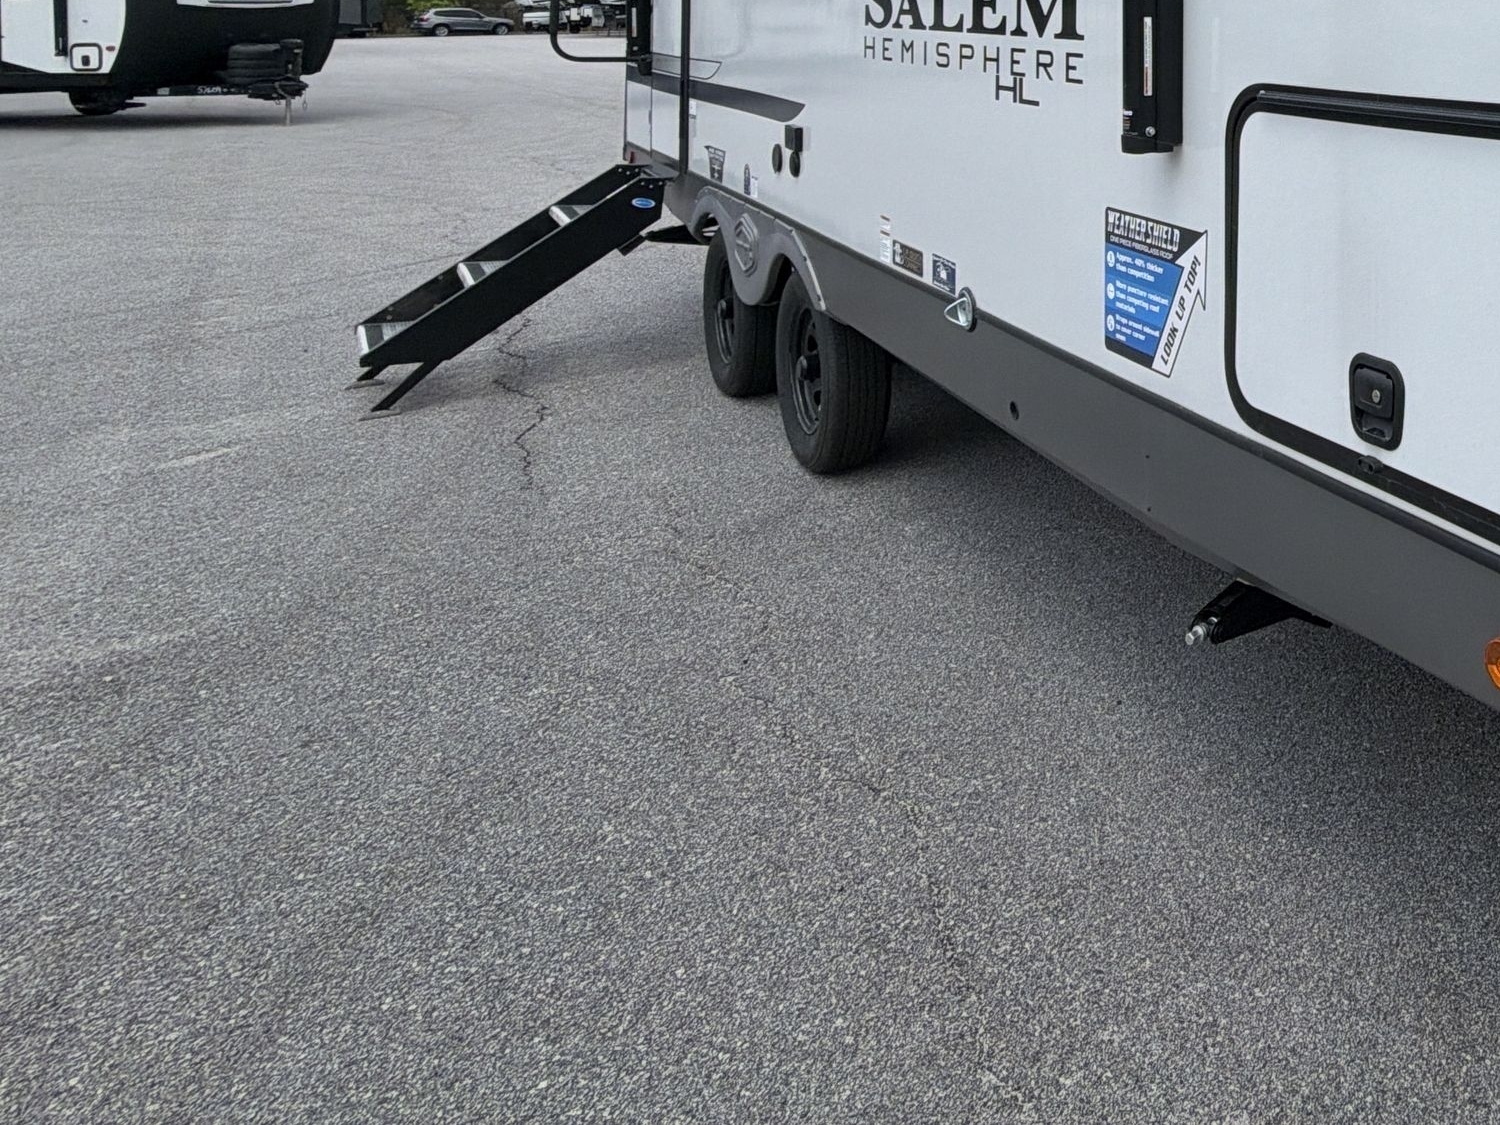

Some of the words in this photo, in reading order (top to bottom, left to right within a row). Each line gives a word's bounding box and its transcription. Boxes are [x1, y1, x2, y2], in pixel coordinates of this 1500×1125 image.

[863, 35, 1084, 85] HEMISPHERE
[995, 75, 1040, 107] HL
[1160, 322, 1179, 366] LOOK
[1175, 296, 1186, 321] UP
[1183, 255, 1201, 294] TOP!
